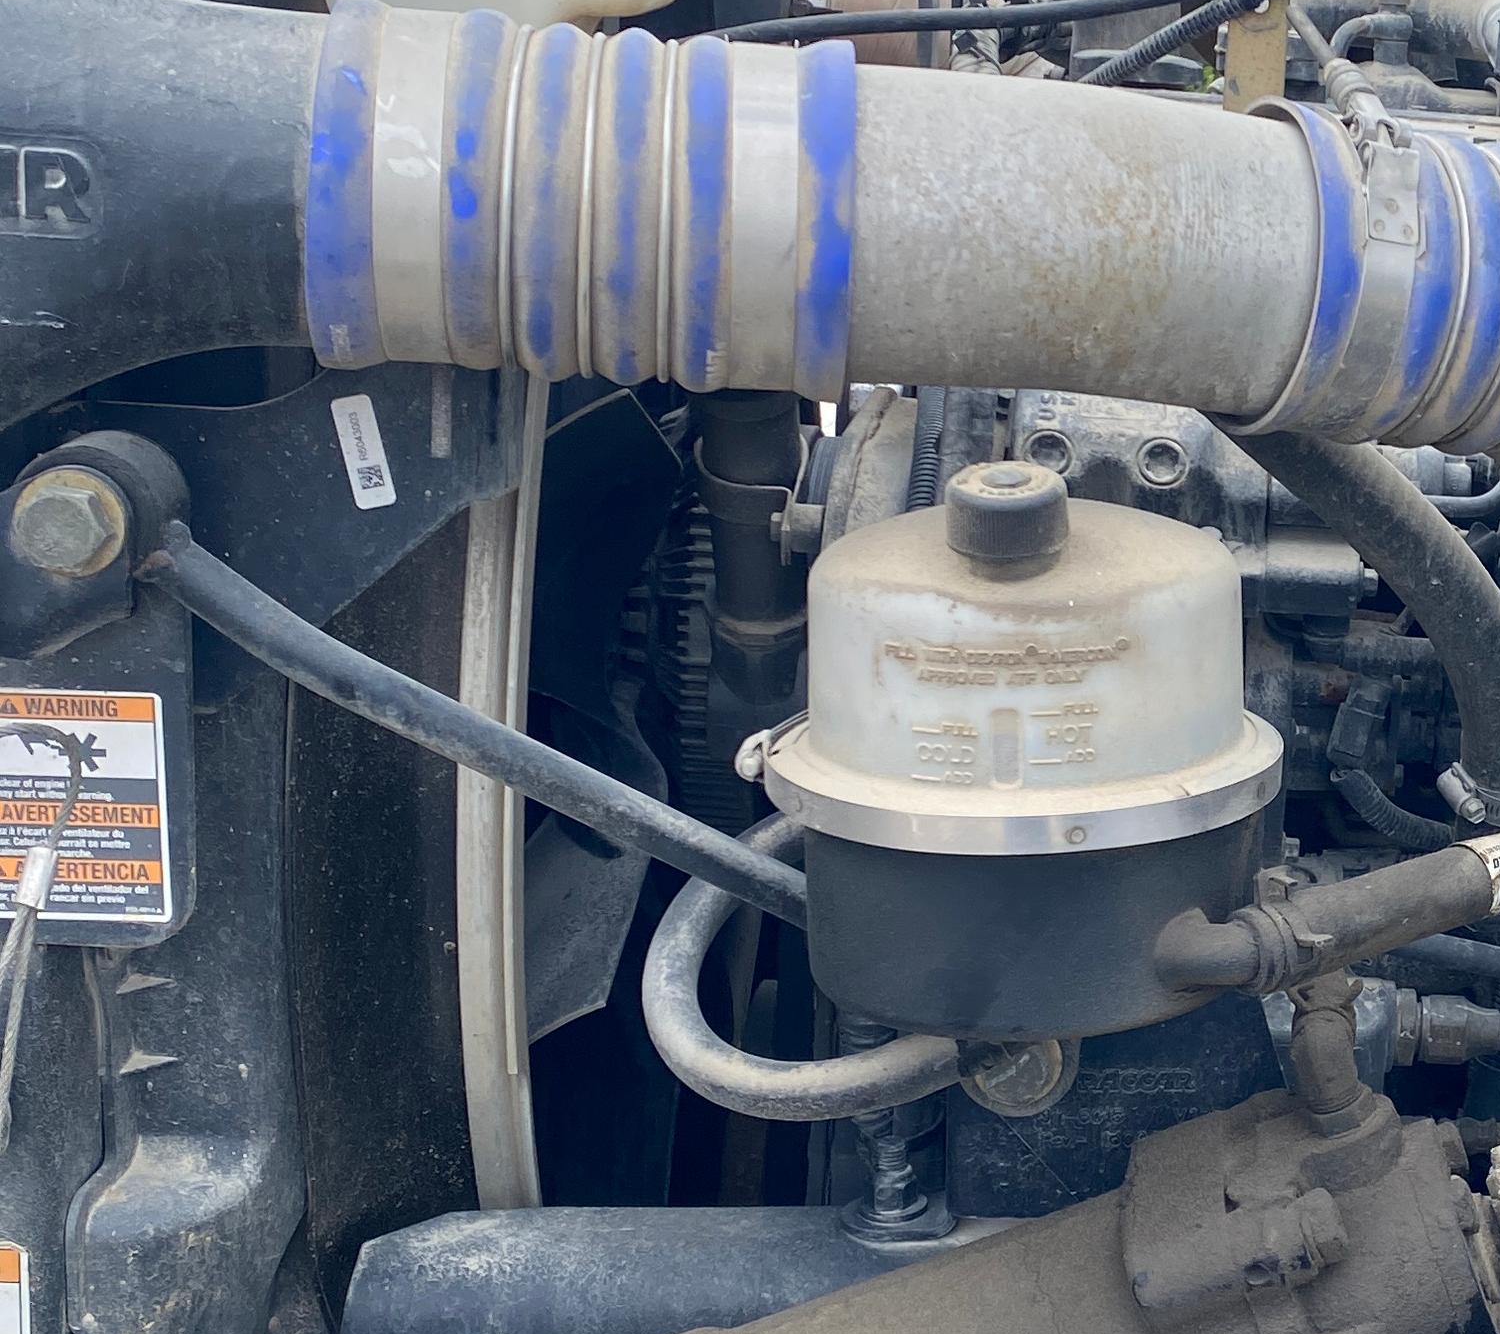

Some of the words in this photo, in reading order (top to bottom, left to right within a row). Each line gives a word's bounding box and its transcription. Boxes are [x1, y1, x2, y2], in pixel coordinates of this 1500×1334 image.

[24, 698, 118, 717] WARNING
[1064, 701, 1099, 717] FULL
[941, 721, 979, 739] FULL
[1046, 722, 1094, 746] HOT
[915, 741, 976, 765] COLD
[1064, 747, 1096, 764] ADD
[943, 771, 975, 785] ADD
[1, 803, 154, 824] AVERTSSEMENT
